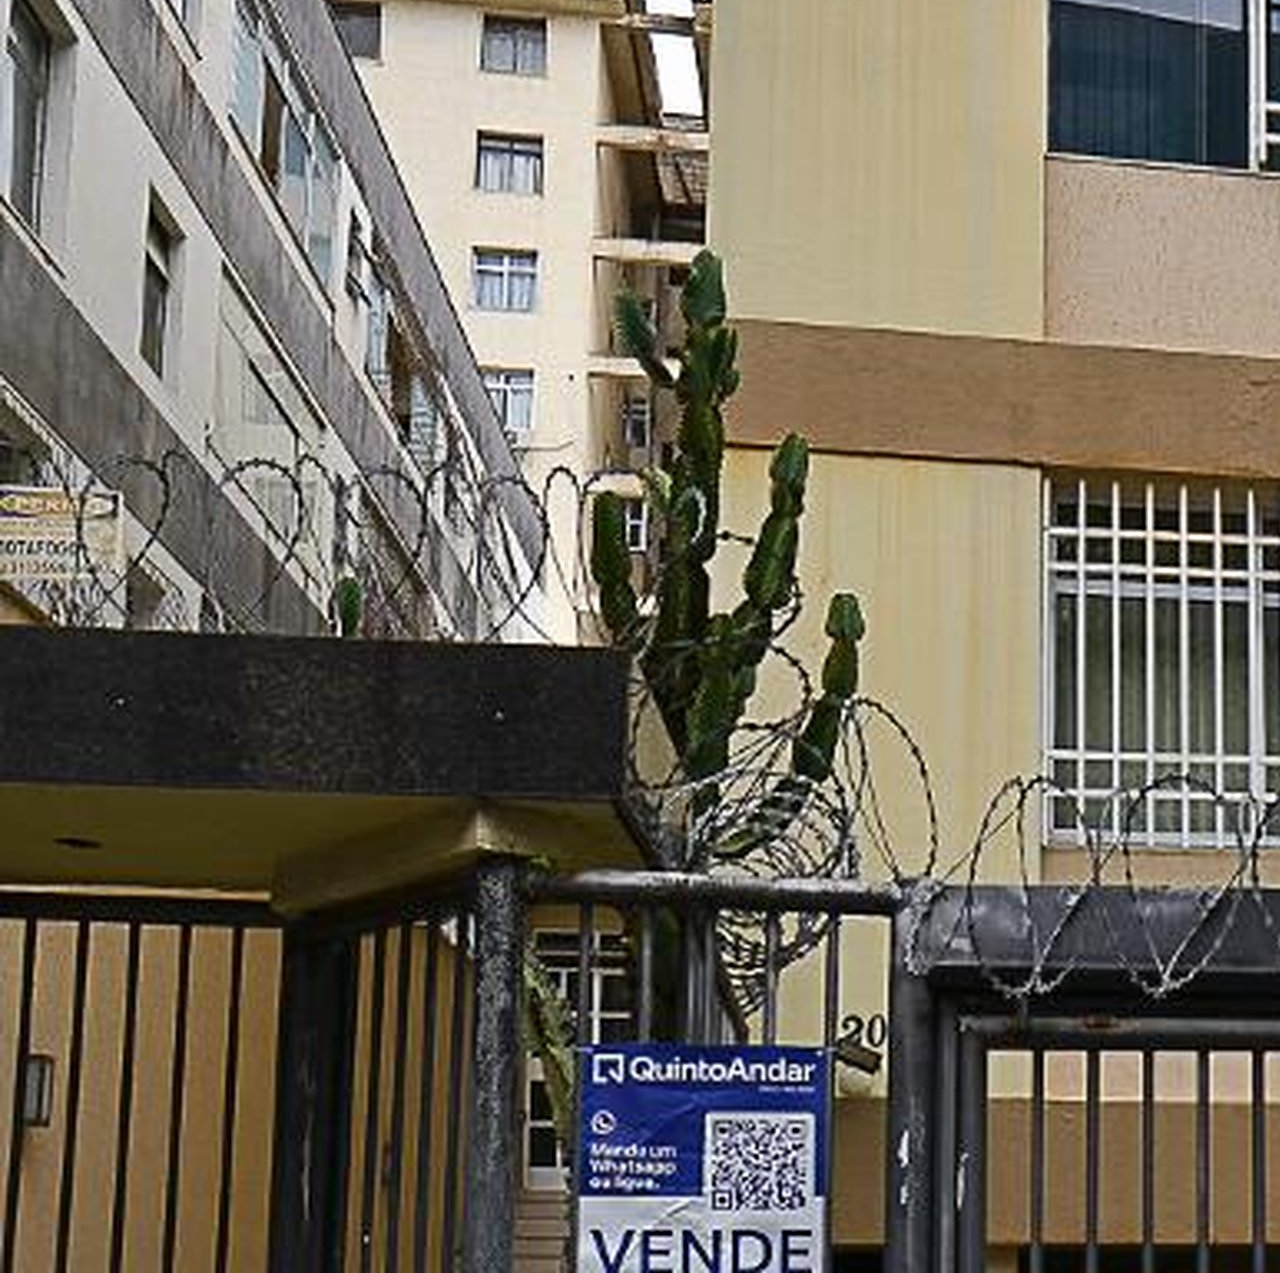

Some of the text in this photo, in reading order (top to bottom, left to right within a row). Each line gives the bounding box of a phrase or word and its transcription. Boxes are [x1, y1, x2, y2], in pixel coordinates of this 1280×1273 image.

[629, 1056, 816, 1082] QuintoAndar
[649, 1146, 678, 1159] um
[588, 1229, 813, 1273] VENDE
